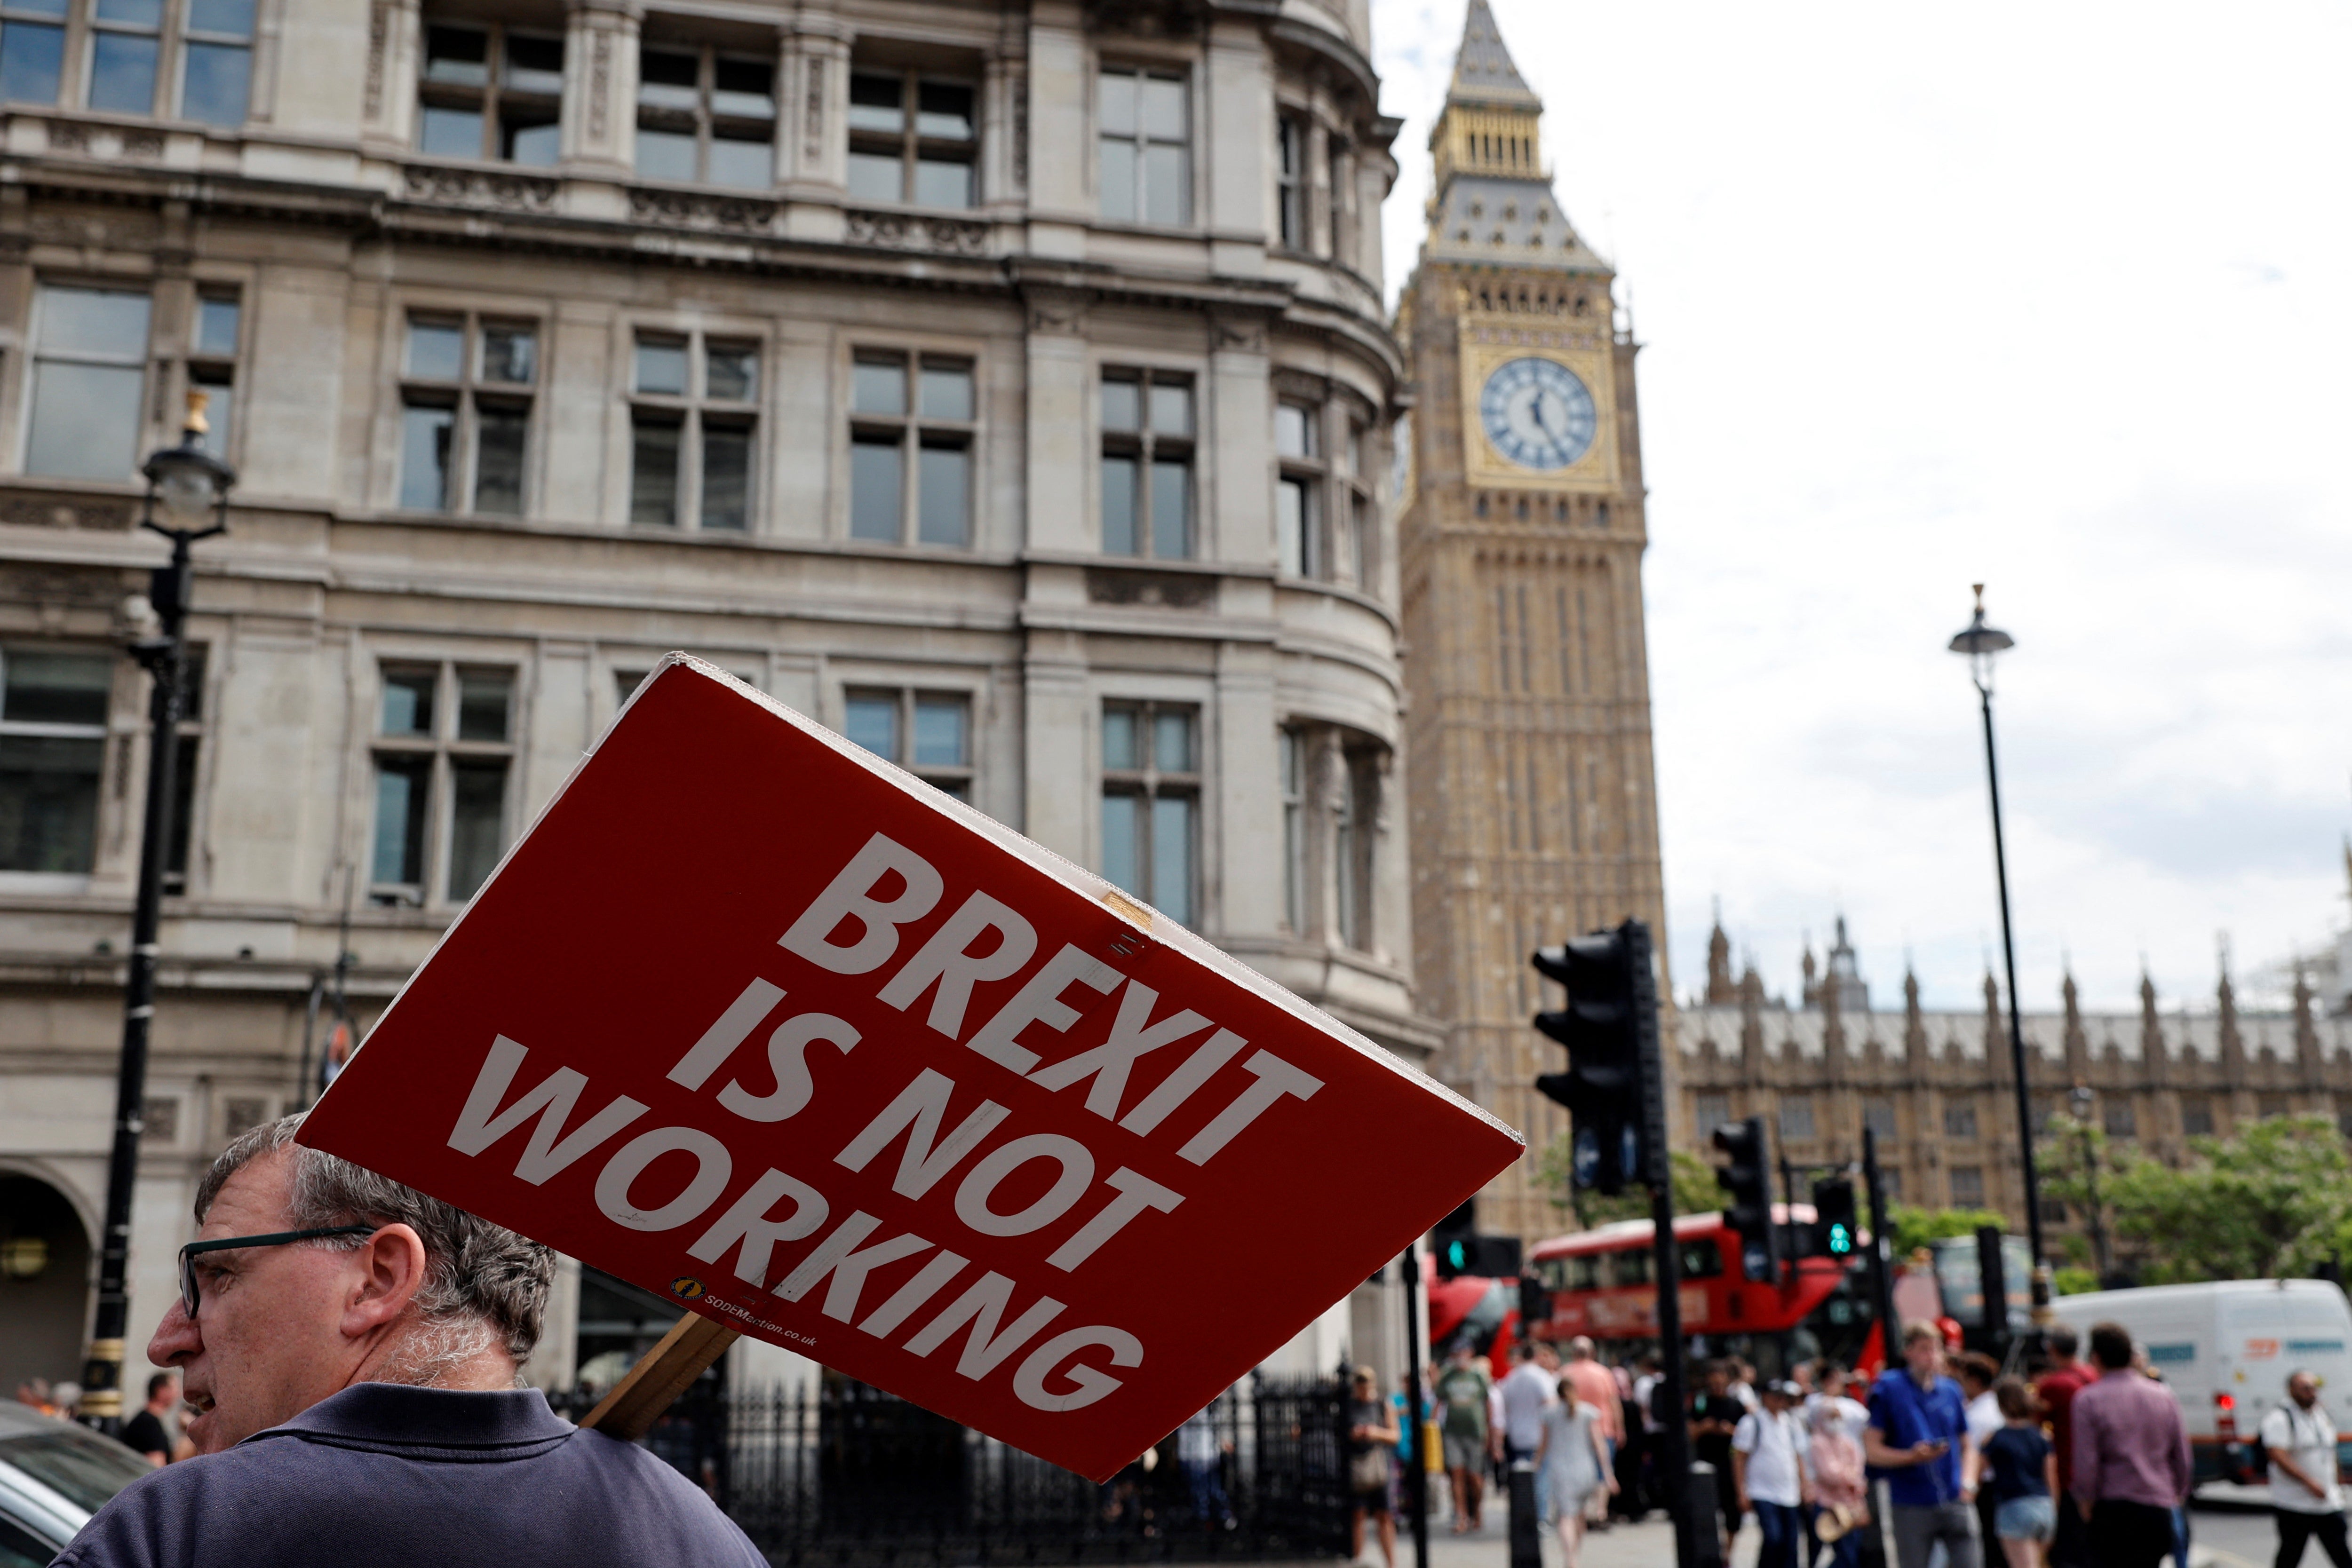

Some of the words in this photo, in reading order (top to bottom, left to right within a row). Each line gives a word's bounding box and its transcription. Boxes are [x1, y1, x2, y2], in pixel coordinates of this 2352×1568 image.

[666, 977, 862, 1122] IS
[833, 1067, 1186, 1273] NOT
[777, 832, 1325, 1167] BREXIT
[447, 1034, 1144, 1412] WORKING
[705, 1295, 817, 1346] SODEMaction.co.uk
